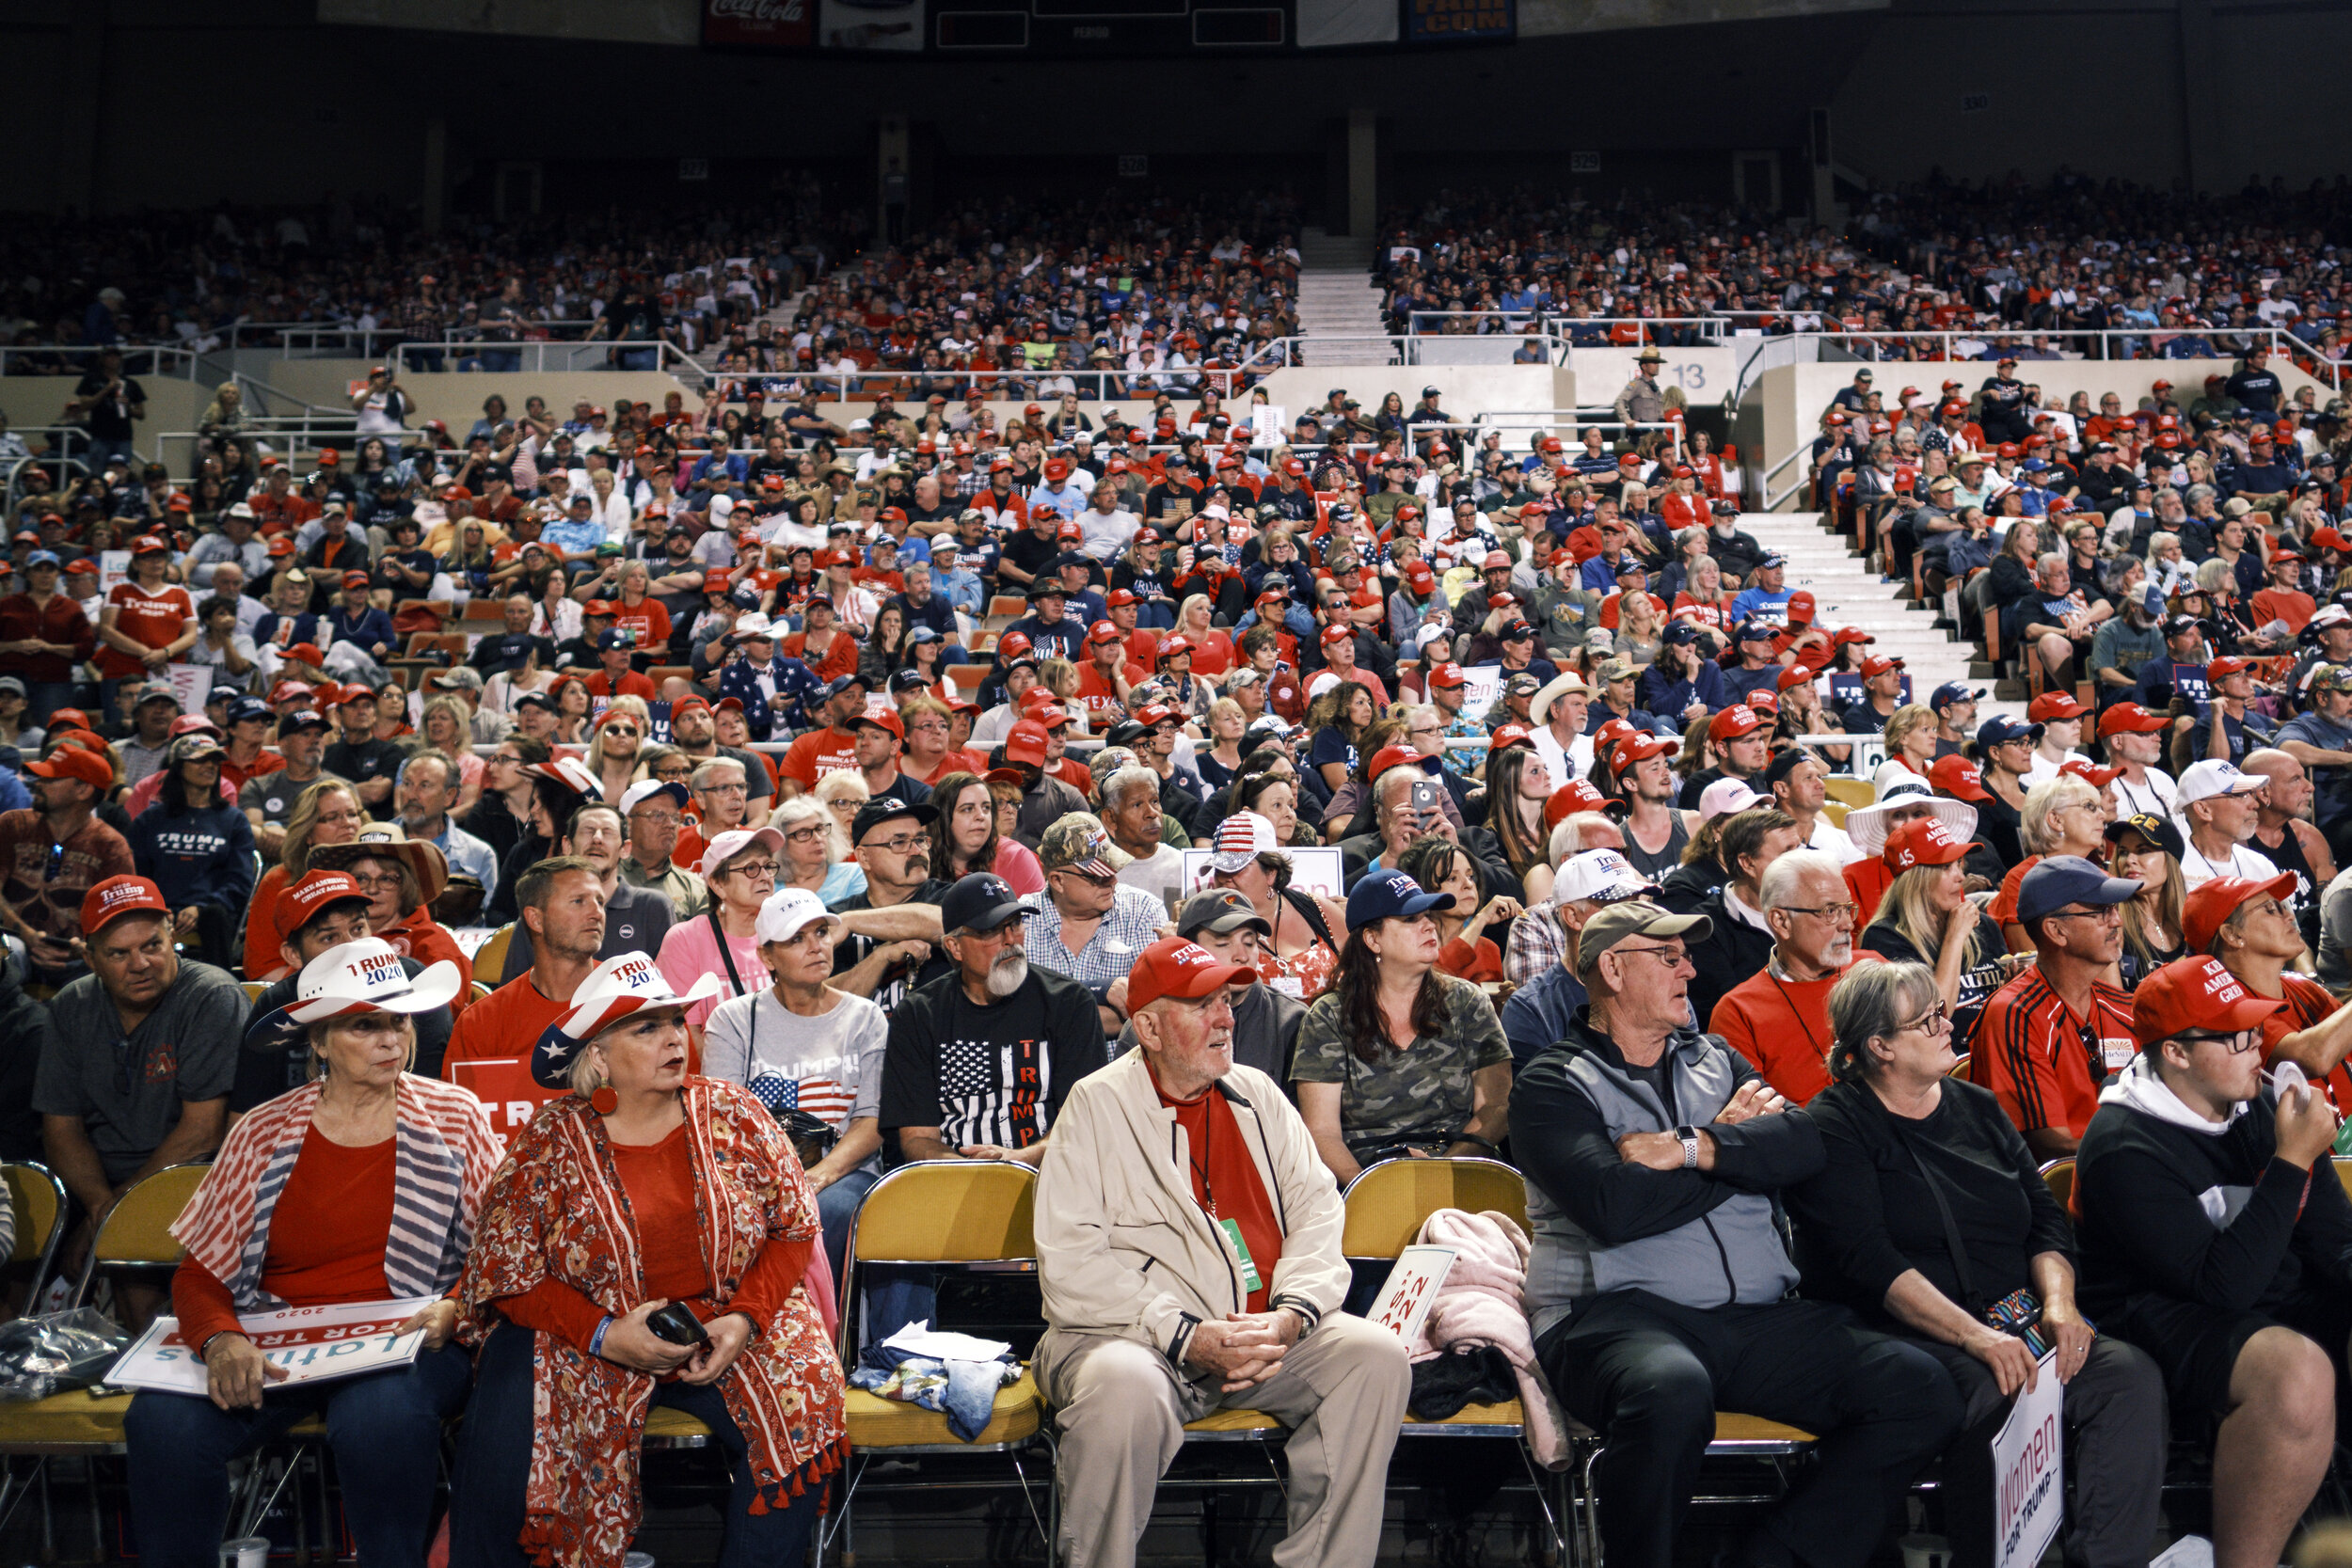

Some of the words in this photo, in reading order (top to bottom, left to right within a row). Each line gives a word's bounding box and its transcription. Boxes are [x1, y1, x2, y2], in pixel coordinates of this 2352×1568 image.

[1416, 10, 1508, 33] .COM
[1963, 94, 1988, 111] 330
[1119, 157, 1146, 173] 328
[1572, 153, 1598, 169] 329
[1671, 363, 1706, 389] 13
[955, 552, 985, 562] Trump
[123, 597, 180, 612] Trump
[816, 754, 850, 765] AMERICA
[836, 748, 854, 756] KEEP
[1615, 751, 1627, 764] 45
[156, 832, 226, 847] TRUMP
[159, 841, 217, 852] PENCE
[1899, 847, 1915, 866] 45
[101, 885, 145, 902] Trump
[113, 882, 132, 891] 2020
[293, 883, 316, 899] MAKE
[315, 877, 349, 890] AMERICA
[300, 888, 326, 904] GREAT
[326, 883, 350, 895] AGAIN
[365, 964, 403, 986] 2020
[1012, 1039, 1035, 1148] TRUMP
[277, 1307, 325, 1320] 2020
[326, 1320, 402, 1338] FOR
[2000, 1413, 2056, 1542] Women
[2005, 1522, 2021, 1558] FOR
[2021, 1474, 2052, 1522] TRUMP
